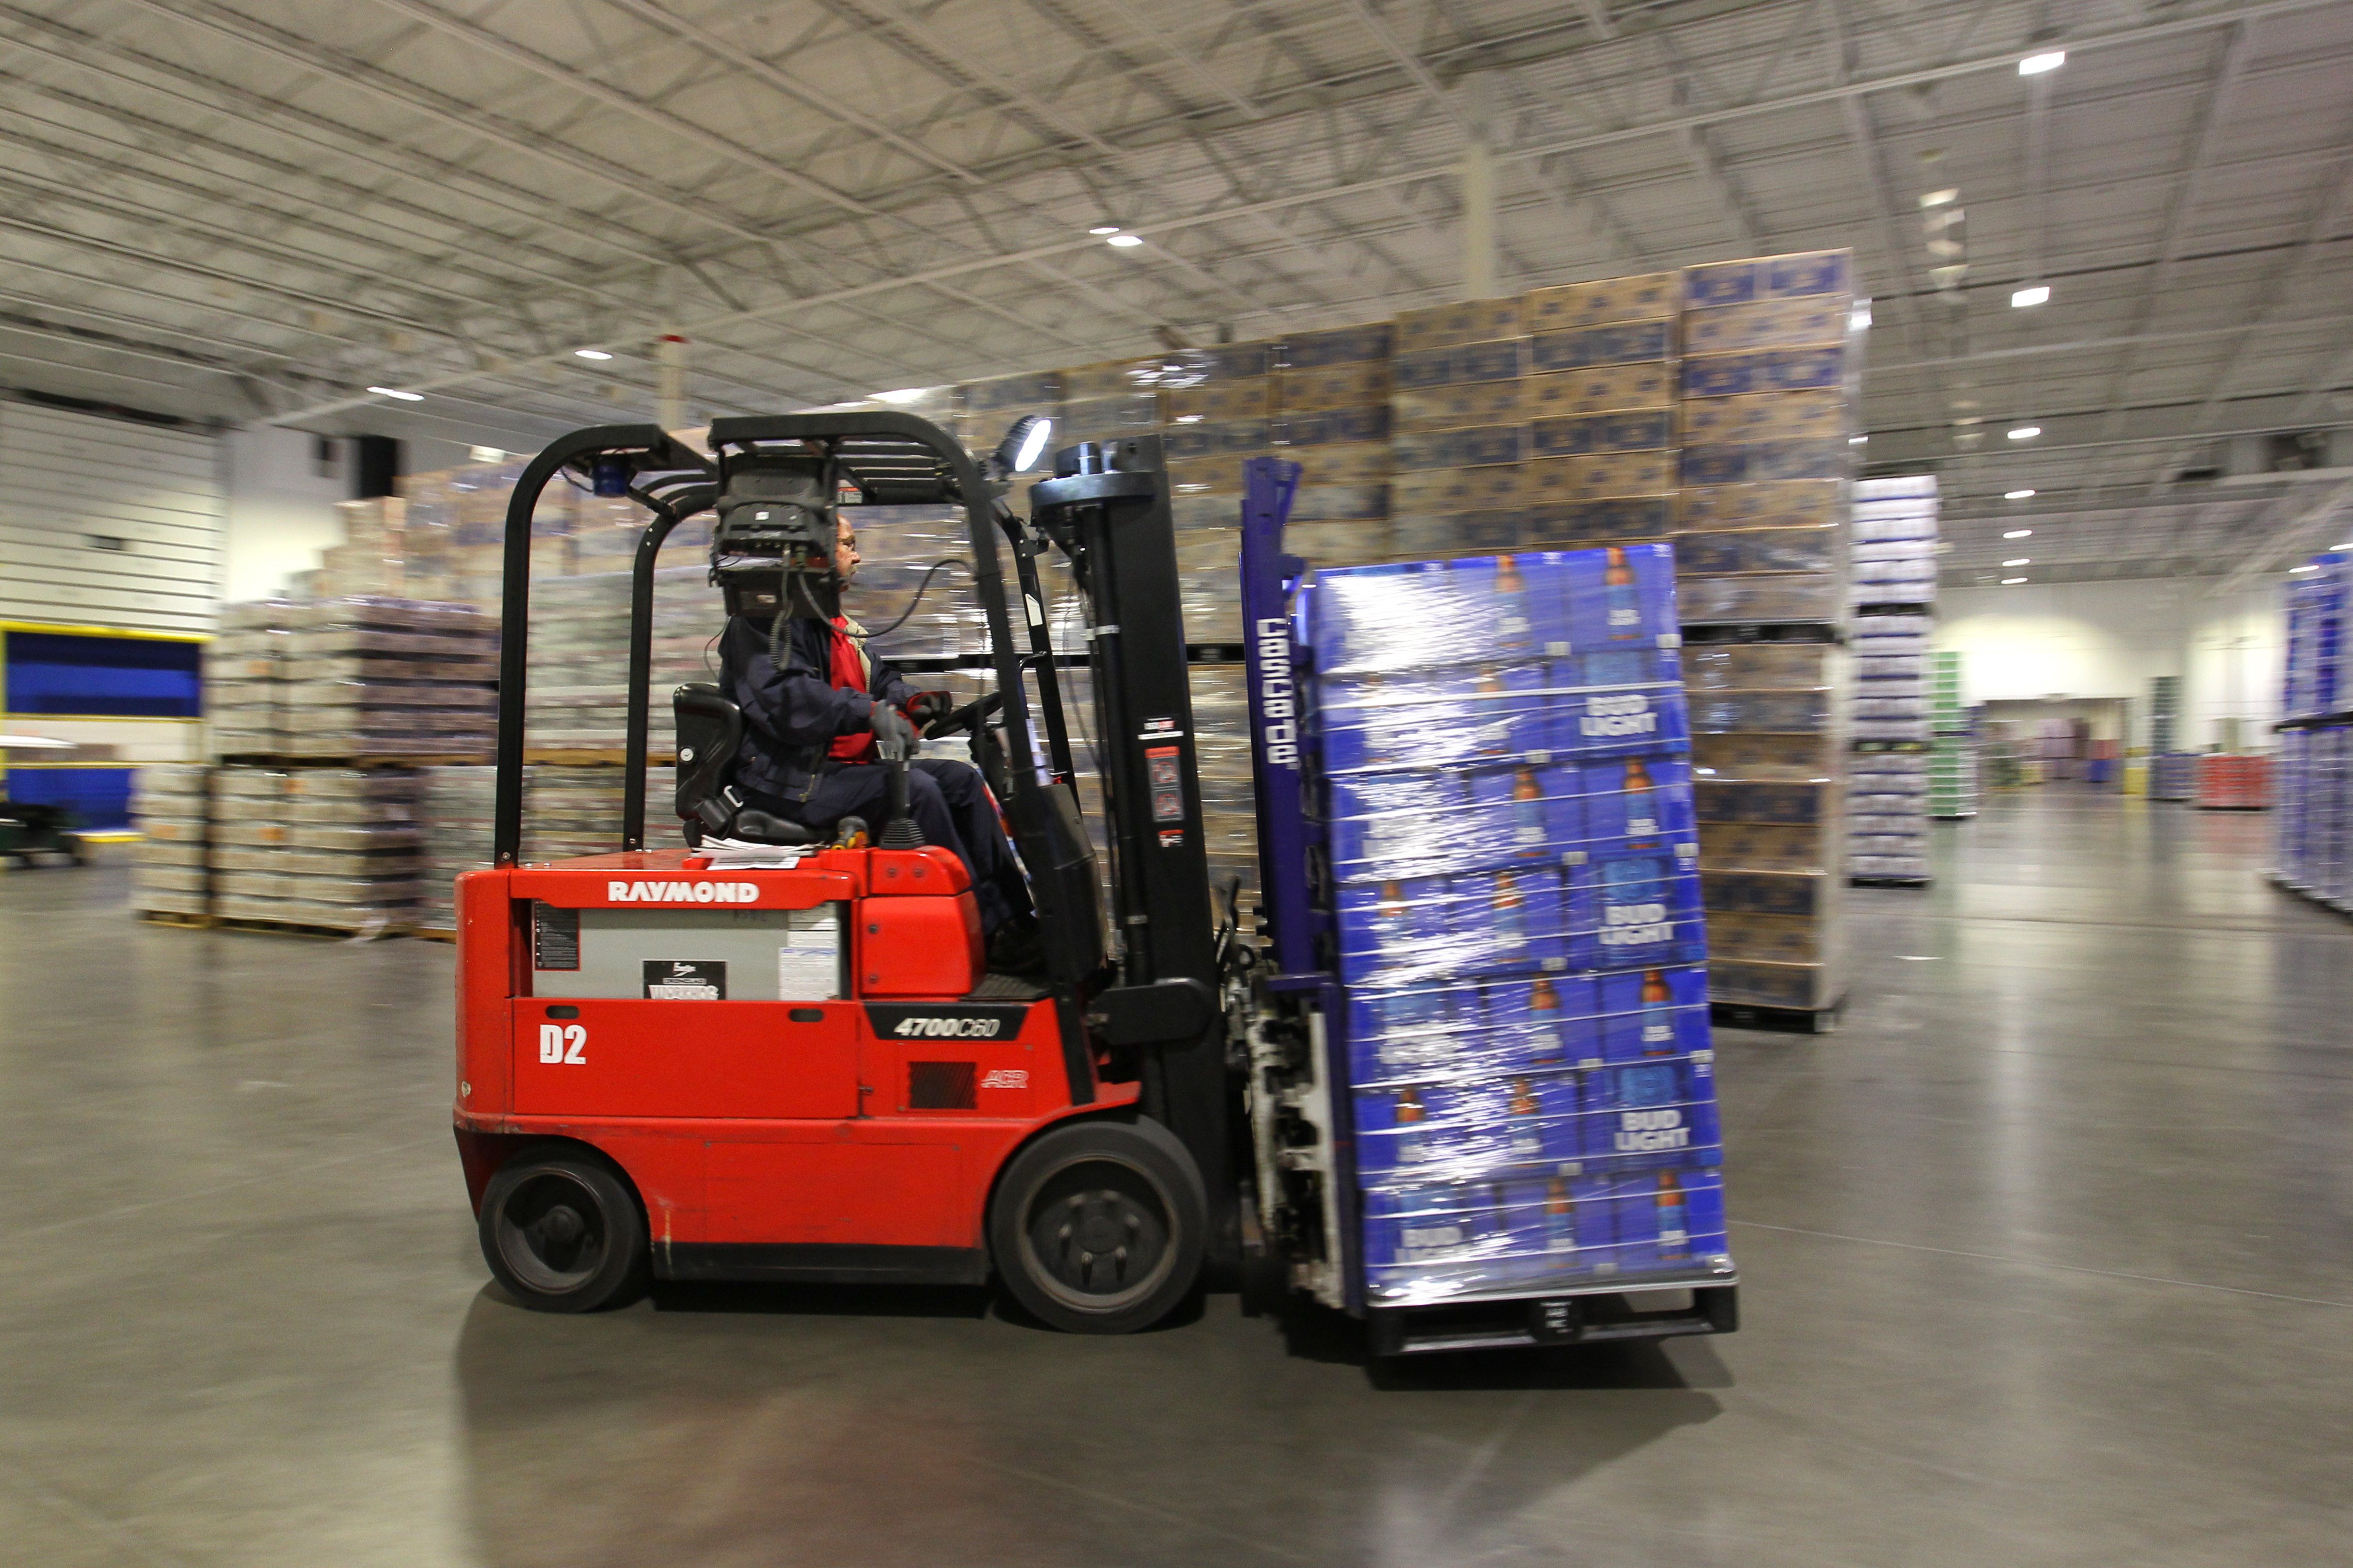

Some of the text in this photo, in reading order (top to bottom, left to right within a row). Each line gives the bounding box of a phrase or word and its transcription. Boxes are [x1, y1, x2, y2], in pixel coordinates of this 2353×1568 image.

[1586, 694, 1650, 716] BUD
[1580, 712, 1658, 736] LIGHT
[608, 881, 760, 903] RAYMOND
[1605, 903, 1667, 925] BUD
[1599, 923, 1673, 945] LIGHT
[894, 1018, 1000, 1037] 4700C60
[539, 1024, 587, 1065] D2
[1621, 1110, 1682, 1131] BUD
[1614, 1127, 1690, 1151] LIGHT
[1401, 1227, 1463, 1248] BUD
